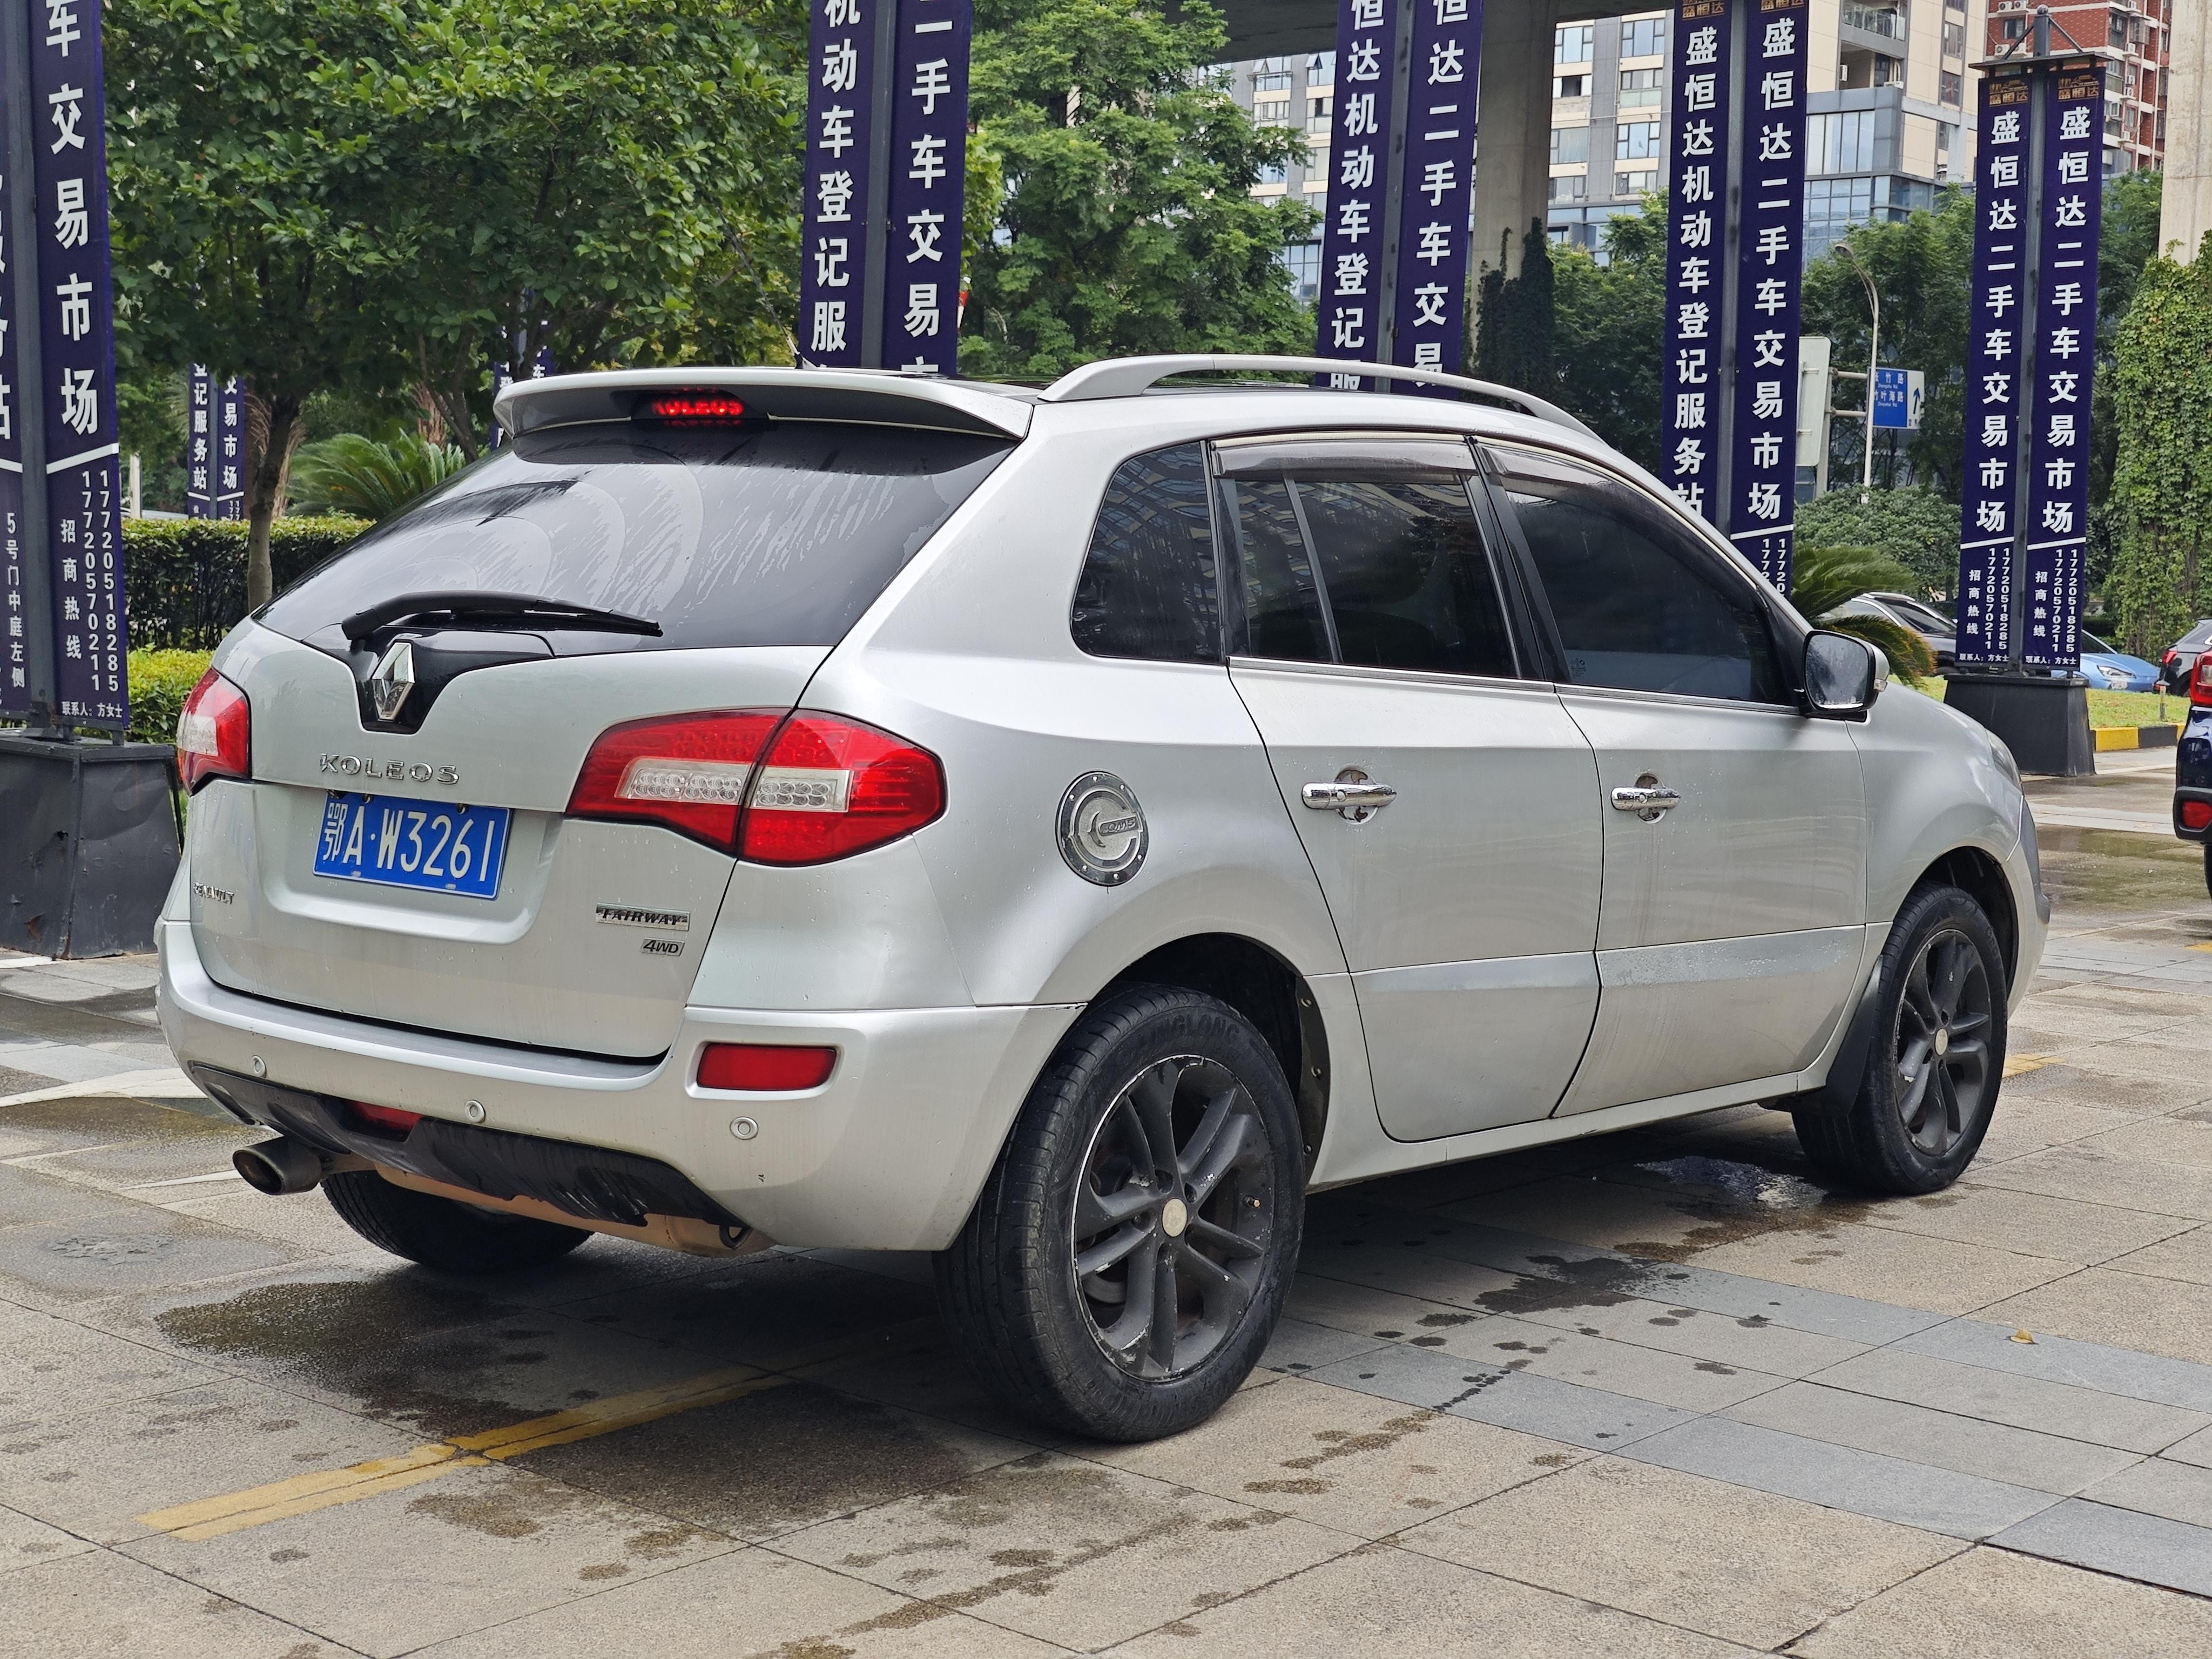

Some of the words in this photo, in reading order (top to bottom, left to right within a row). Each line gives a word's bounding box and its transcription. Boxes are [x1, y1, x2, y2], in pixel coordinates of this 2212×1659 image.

[1990, 91, 2028, 105] 盛恒达
[2058, 86, 2099, 100] 盛恒达
[46, 0, 98, 435] 车交易市场
[1748, 17, 1796, 520] 盛恒达二手车交易市场
[1673, 26, 1718, 516] 盛恒达机动车登记服务站
[1977, 111, 2020, 532] 盛恒达二手车交易市场
[2042, 106, 2092, 533] 盛恒达二手车交易市场
[6, 512, 25, 688] 5号门中庭左侧
[61, 519, 82, 659] 招商热线
[82, 470, 101, 691] 17720570211
[100, 470, 119, 692] 17720518285
[1967, 569, 1981, 635] 招商热线
[1985, 548, 1996, 649] 17720570211
[1999, 548, 2010, 649] 17720518285
[2033, 571, 2048, 637] 招商热线
[2052, 549, 2063, 652] 17720570211
[2066, 549, 2078, 652] 17720518285
[320, 752, 460, 785] KOLEOS
[602, 908, 682, 926] FAIRWAY
[643, 940, 679, 954] 4WD
